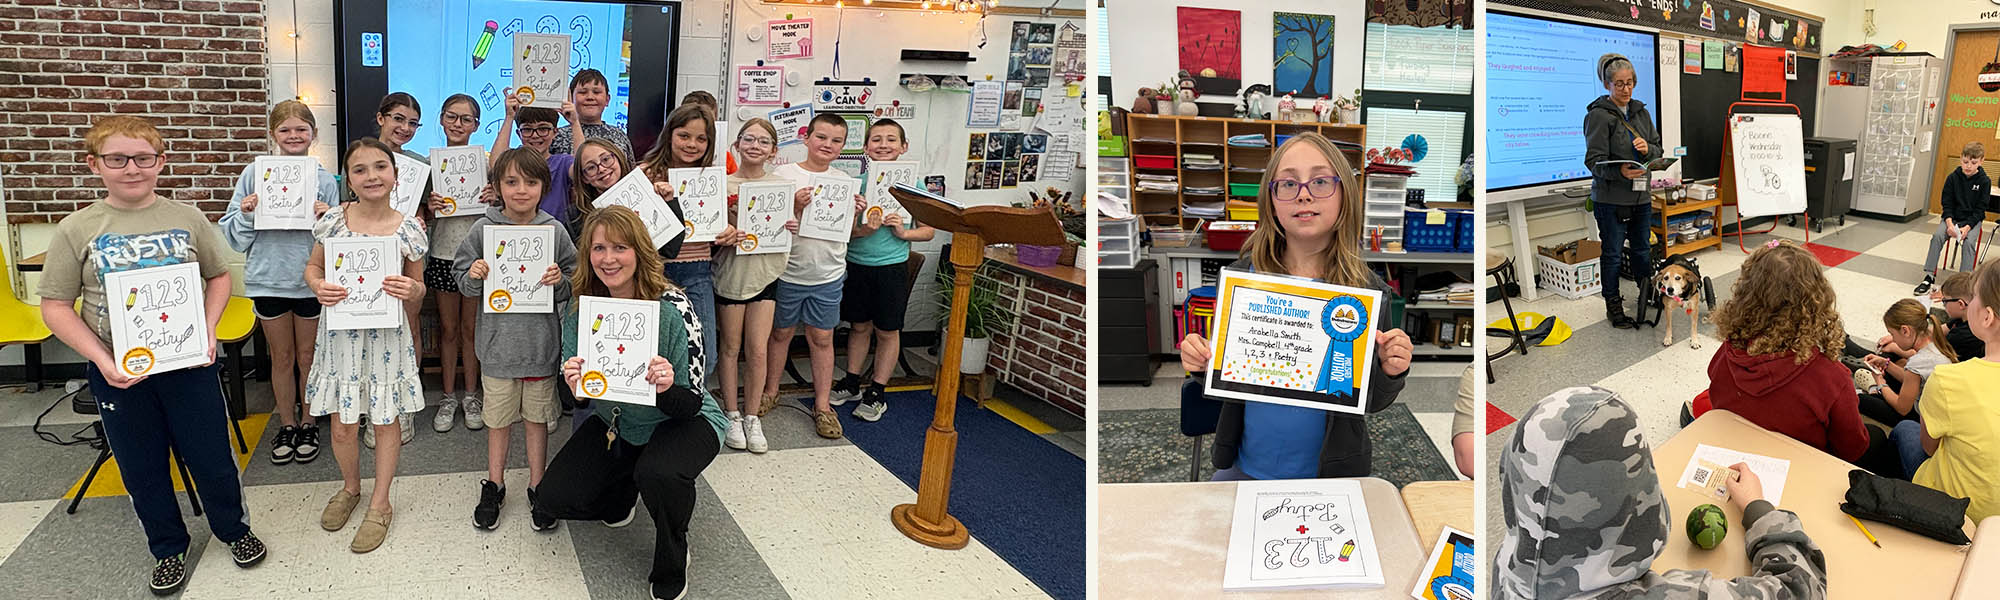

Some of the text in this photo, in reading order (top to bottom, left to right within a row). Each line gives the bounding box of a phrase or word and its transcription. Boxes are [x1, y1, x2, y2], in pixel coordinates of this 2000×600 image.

[843, 87, 850, 95] I
[1950, 93, 1999, 104] Welcome
[835, 96, 856, 104] CAN
[1967, 107, 1977, 117] to
[1945, 118, 1961, 127] 3rd
[1266, 295, 1287, 307] You're
[1248, 302, 1310, 319] PUBLISHED AUTHOR!
[1241, 312, 1251, 320] This
[1251, 315, 1278, 324] certificate
[1284, 320, 1306, 328] awarded
[138, 327, 186, 353] Poetry
[1248, 326, 1301, 341] Arabella Smith
[597, 355, 637, 387] Poetry
[1330, 351, 1345, 381] AUTHOR
[1276, 498, 1338, 522] Poetry
